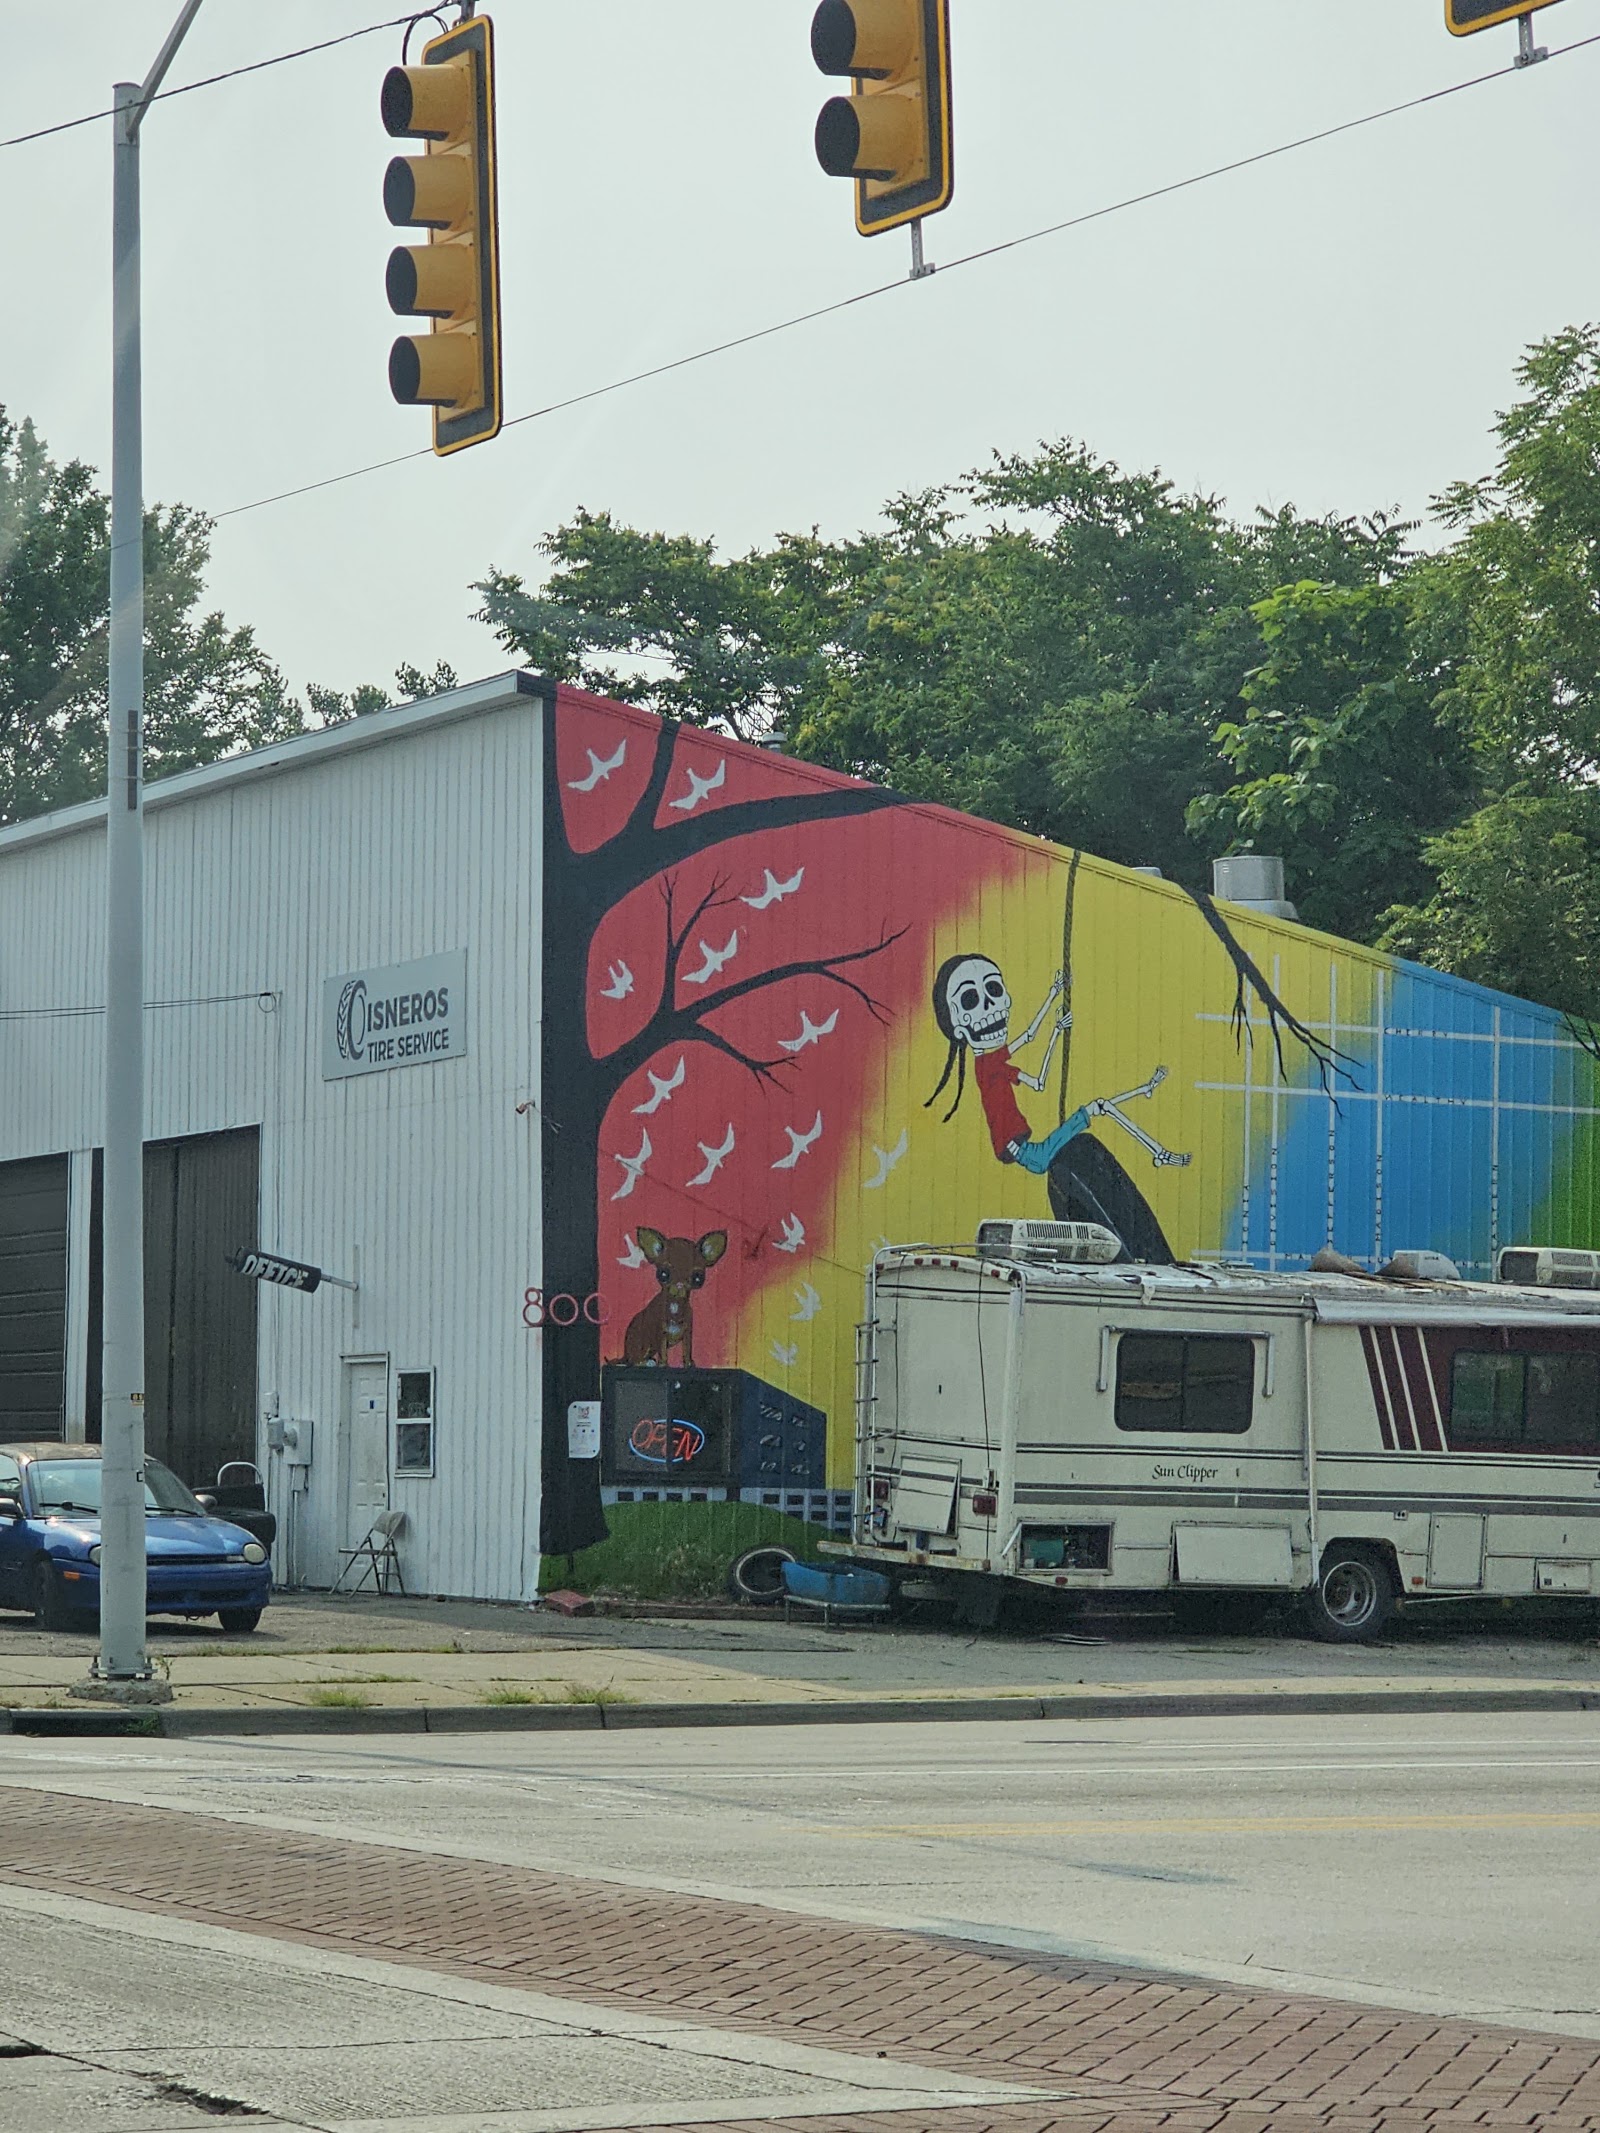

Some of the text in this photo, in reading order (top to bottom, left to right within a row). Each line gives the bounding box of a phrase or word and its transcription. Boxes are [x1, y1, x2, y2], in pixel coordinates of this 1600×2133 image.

[338, 979, 449, 1061] CISNEROS
[367, 1028, 449, 1063] TIRE SERVICE
[1384, 1094, 1467, 1106] WEALTHY
[1270, 1147, 1278, 1247] DIVISION
[1327, 1129, 1335, 1245] JEFFERSON
[1375, 1155, 1383, 1242] MADISON
[1242, 1184, 1251, 1245] IONIA
[523, 1287, 611, 1328] 800
[632, 1419, 700, 1462] OPEN
[1152, 1463, 1219, 1482] Sun Clipper
